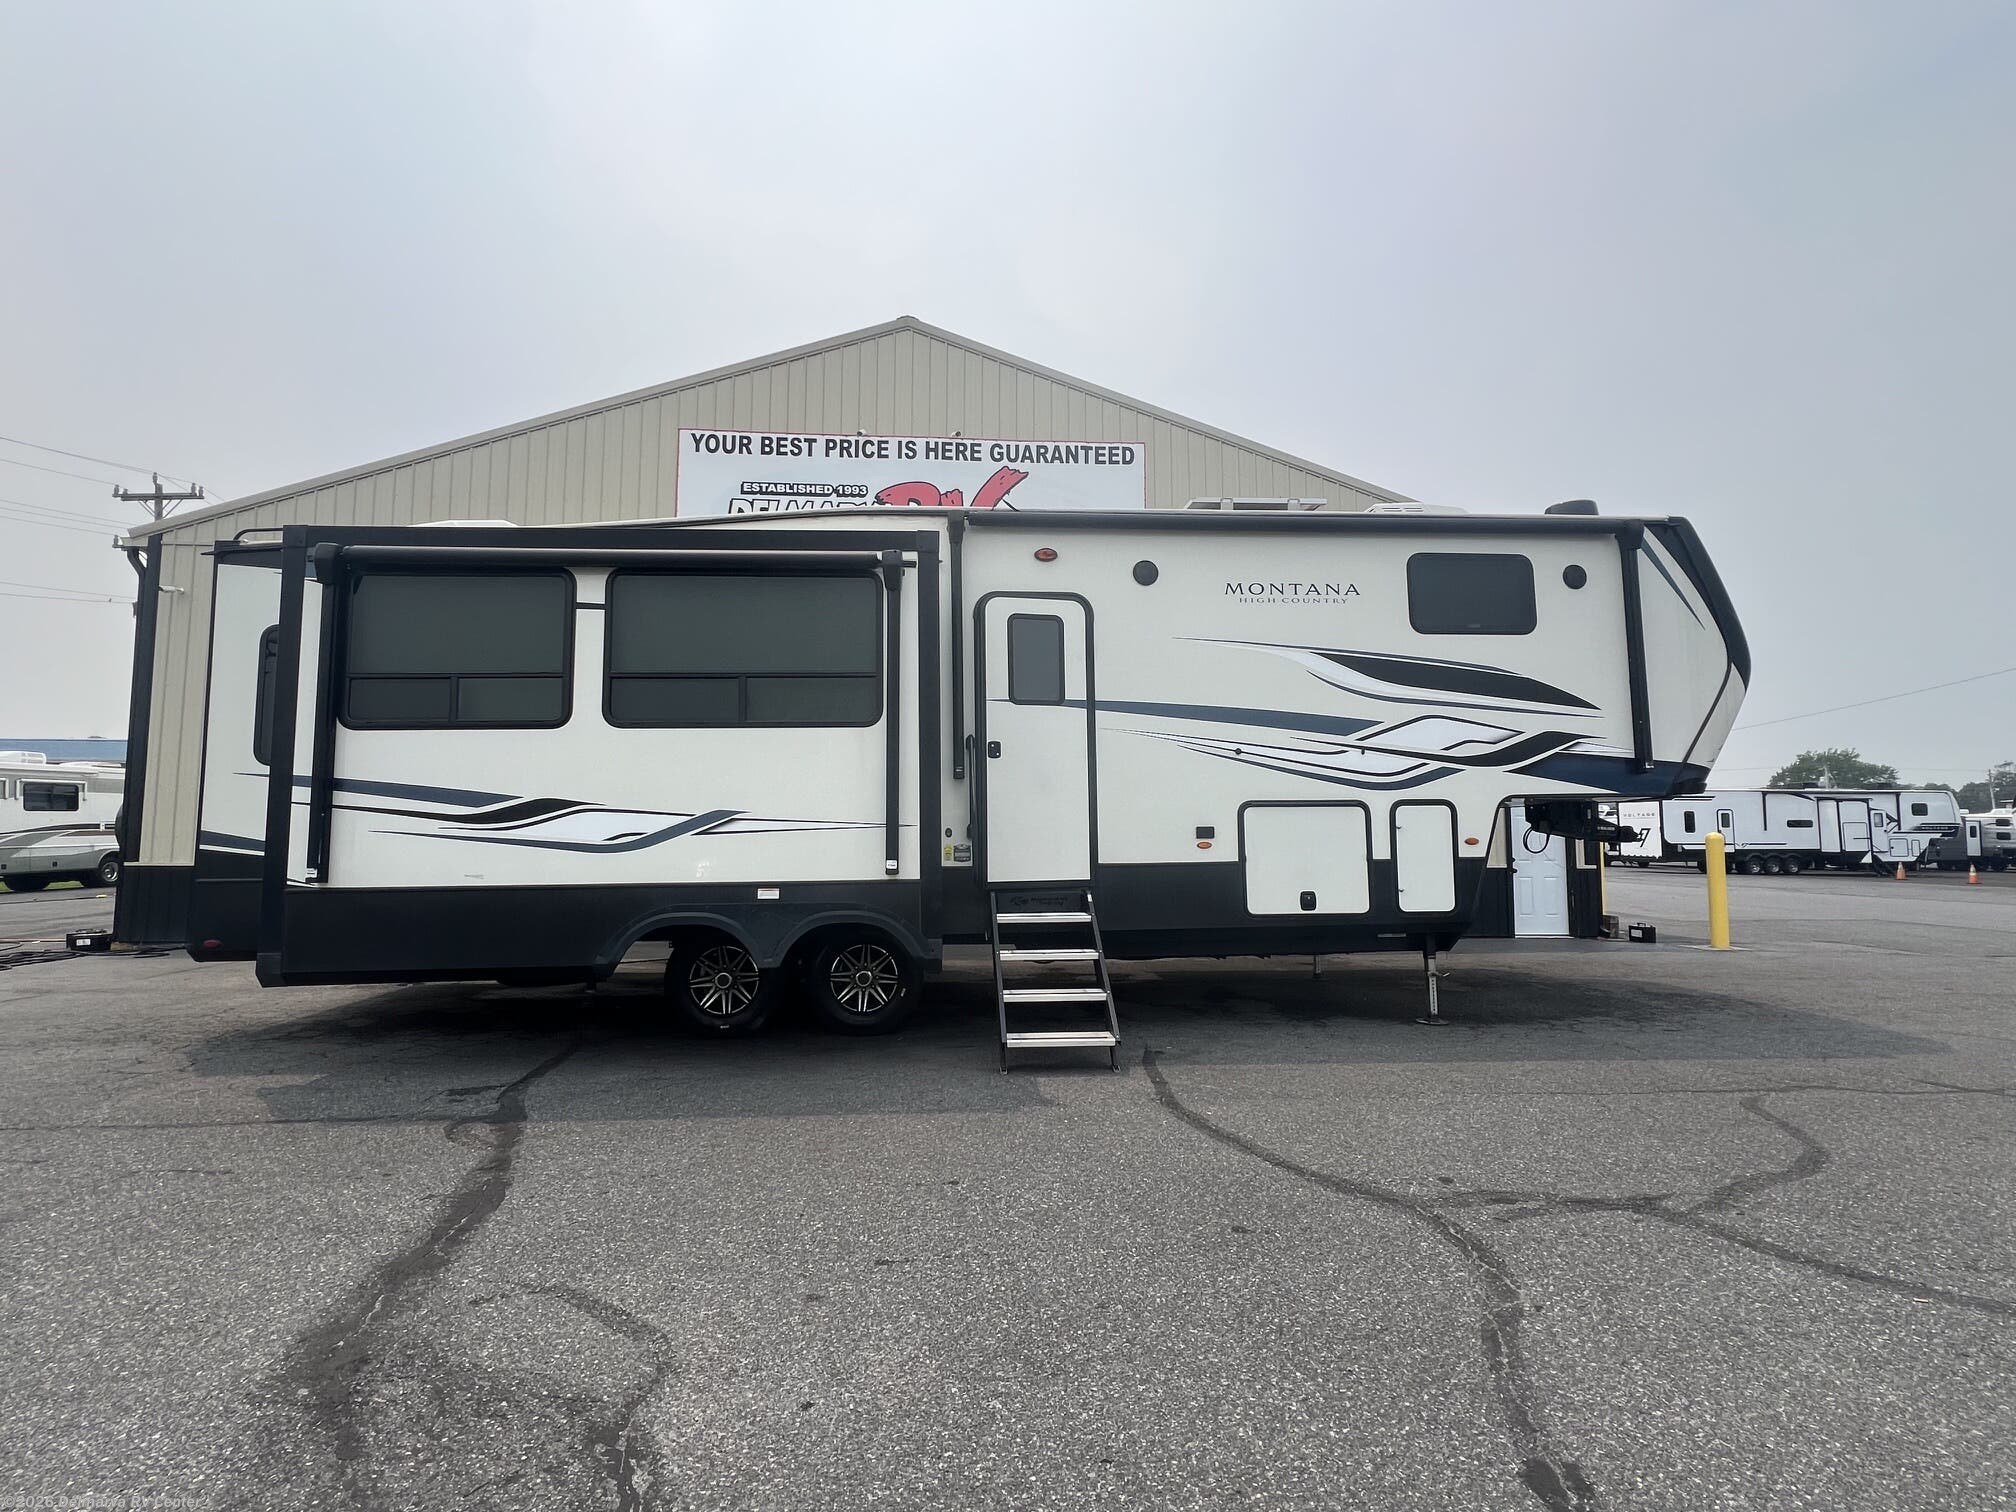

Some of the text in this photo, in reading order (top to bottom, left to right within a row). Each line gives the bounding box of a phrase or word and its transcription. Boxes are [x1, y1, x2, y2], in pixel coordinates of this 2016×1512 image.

[690, 432, 1135, 465] YOUR BEST PRICE IS HERE GUARANTEED
[742, 482, 868, 496] ESTABLISHED 1993
[1225, 582, 1361, 596] MONTANA
